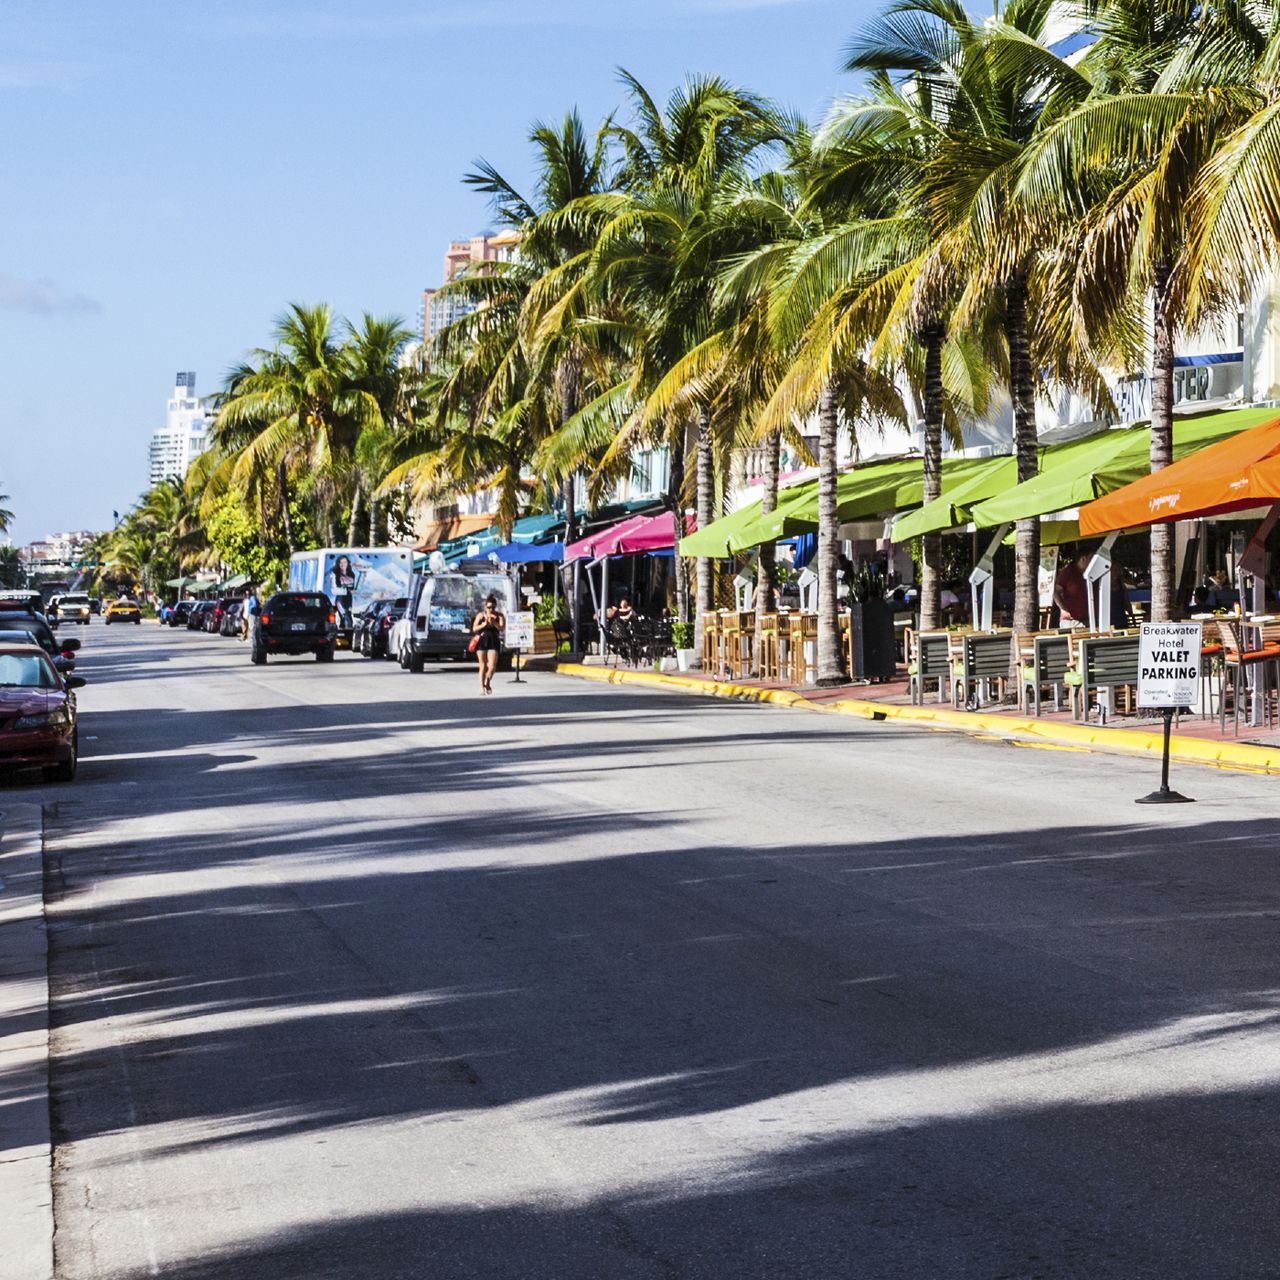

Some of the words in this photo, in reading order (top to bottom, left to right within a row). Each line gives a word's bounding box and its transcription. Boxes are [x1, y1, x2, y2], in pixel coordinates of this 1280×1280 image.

[1143, 626, 1199, 635] Breakwater
[1158, 639, 1184, 648] Hotel
[1152, 650, 1190, 663] VALET
[1142, 667, 1197, 680] PARKING
